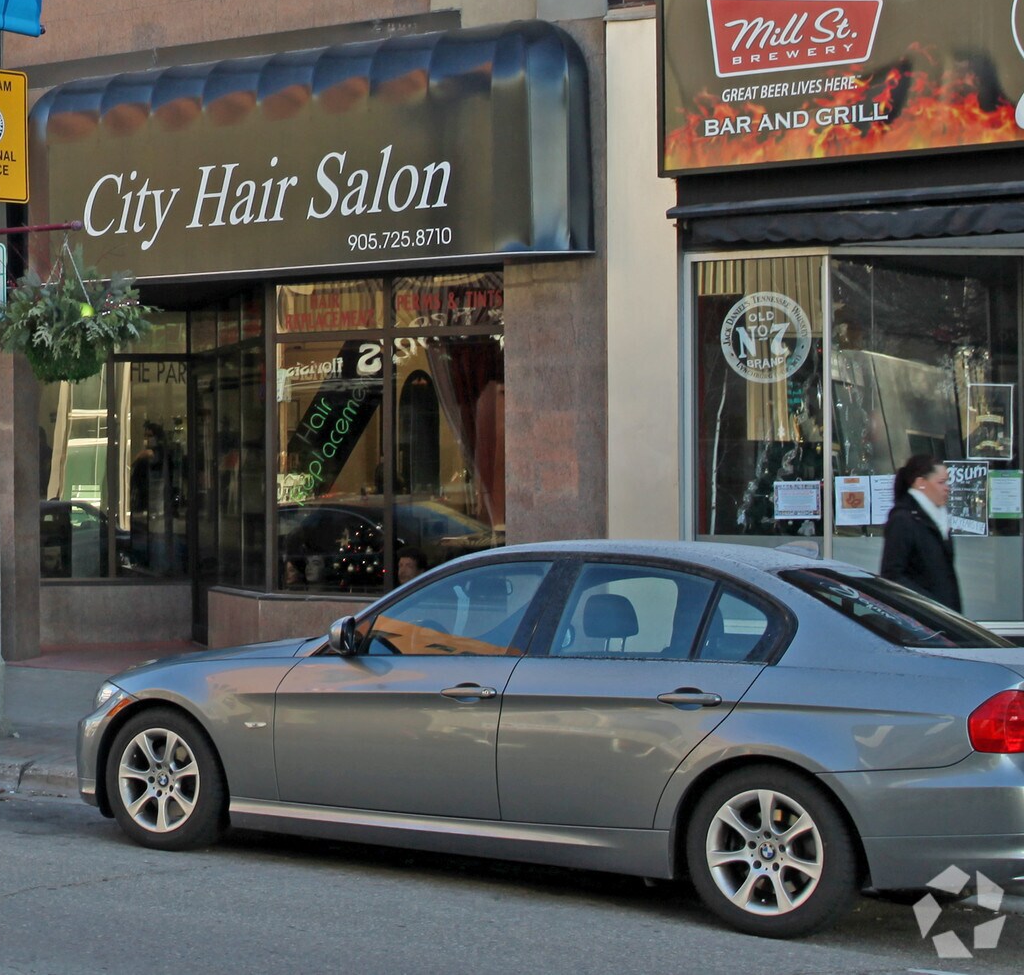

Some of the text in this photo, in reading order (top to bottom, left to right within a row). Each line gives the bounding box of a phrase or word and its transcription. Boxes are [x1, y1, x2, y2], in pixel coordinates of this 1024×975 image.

[724, 7, 858, 52] Mill St.
[732, 43, 853, 65] BREWERY
[721, 85, 758, 103] GREAT
[760, 82, 788, 98] BEER
[791, 79, 822, 96] LIVES
[704, 102, 888, 137] BAR AND GRILL
[83, 144, 451, 251] City Hair Salon
[347, 227, 452, 252] 905.725.8710
[310, 293, 340, 310] HAIR
[396, 289, 503, 311] PERMS & TINTS
[751, 295, 790, 308] TENNESSEE
[748, 311, 775, 323] OLD
[746, 357, 784, 370] BRAND
[296, 397, 332, 445] Hair
